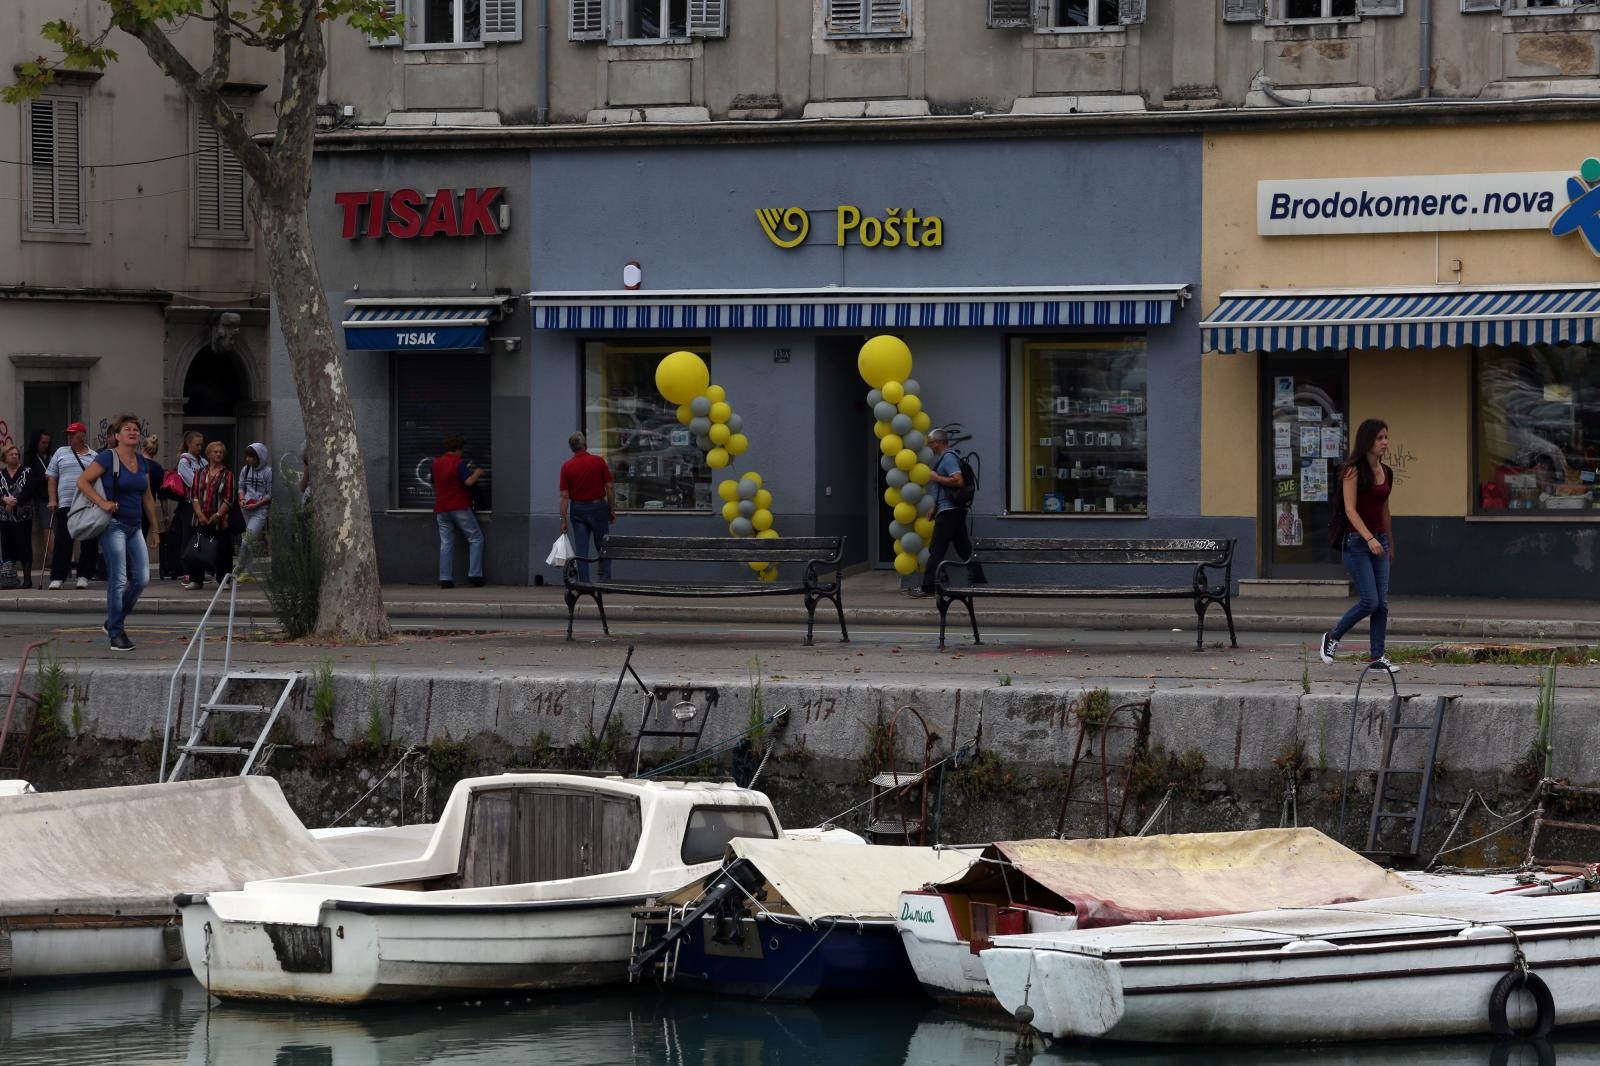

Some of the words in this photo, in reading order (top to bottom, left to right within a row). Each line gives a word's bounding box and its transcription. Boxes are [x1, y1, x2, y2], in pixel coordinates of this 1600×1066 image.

[335, 187, 506, 239] TISAK
[1269, 190, 1554, 220] Brodokomerc.nova
[837, 205, 943, 248] Pošta
[396, 332, 437, 345] TISAK
[533, 689, 567, 716] 116
[802, 698, 837, 723] 117
